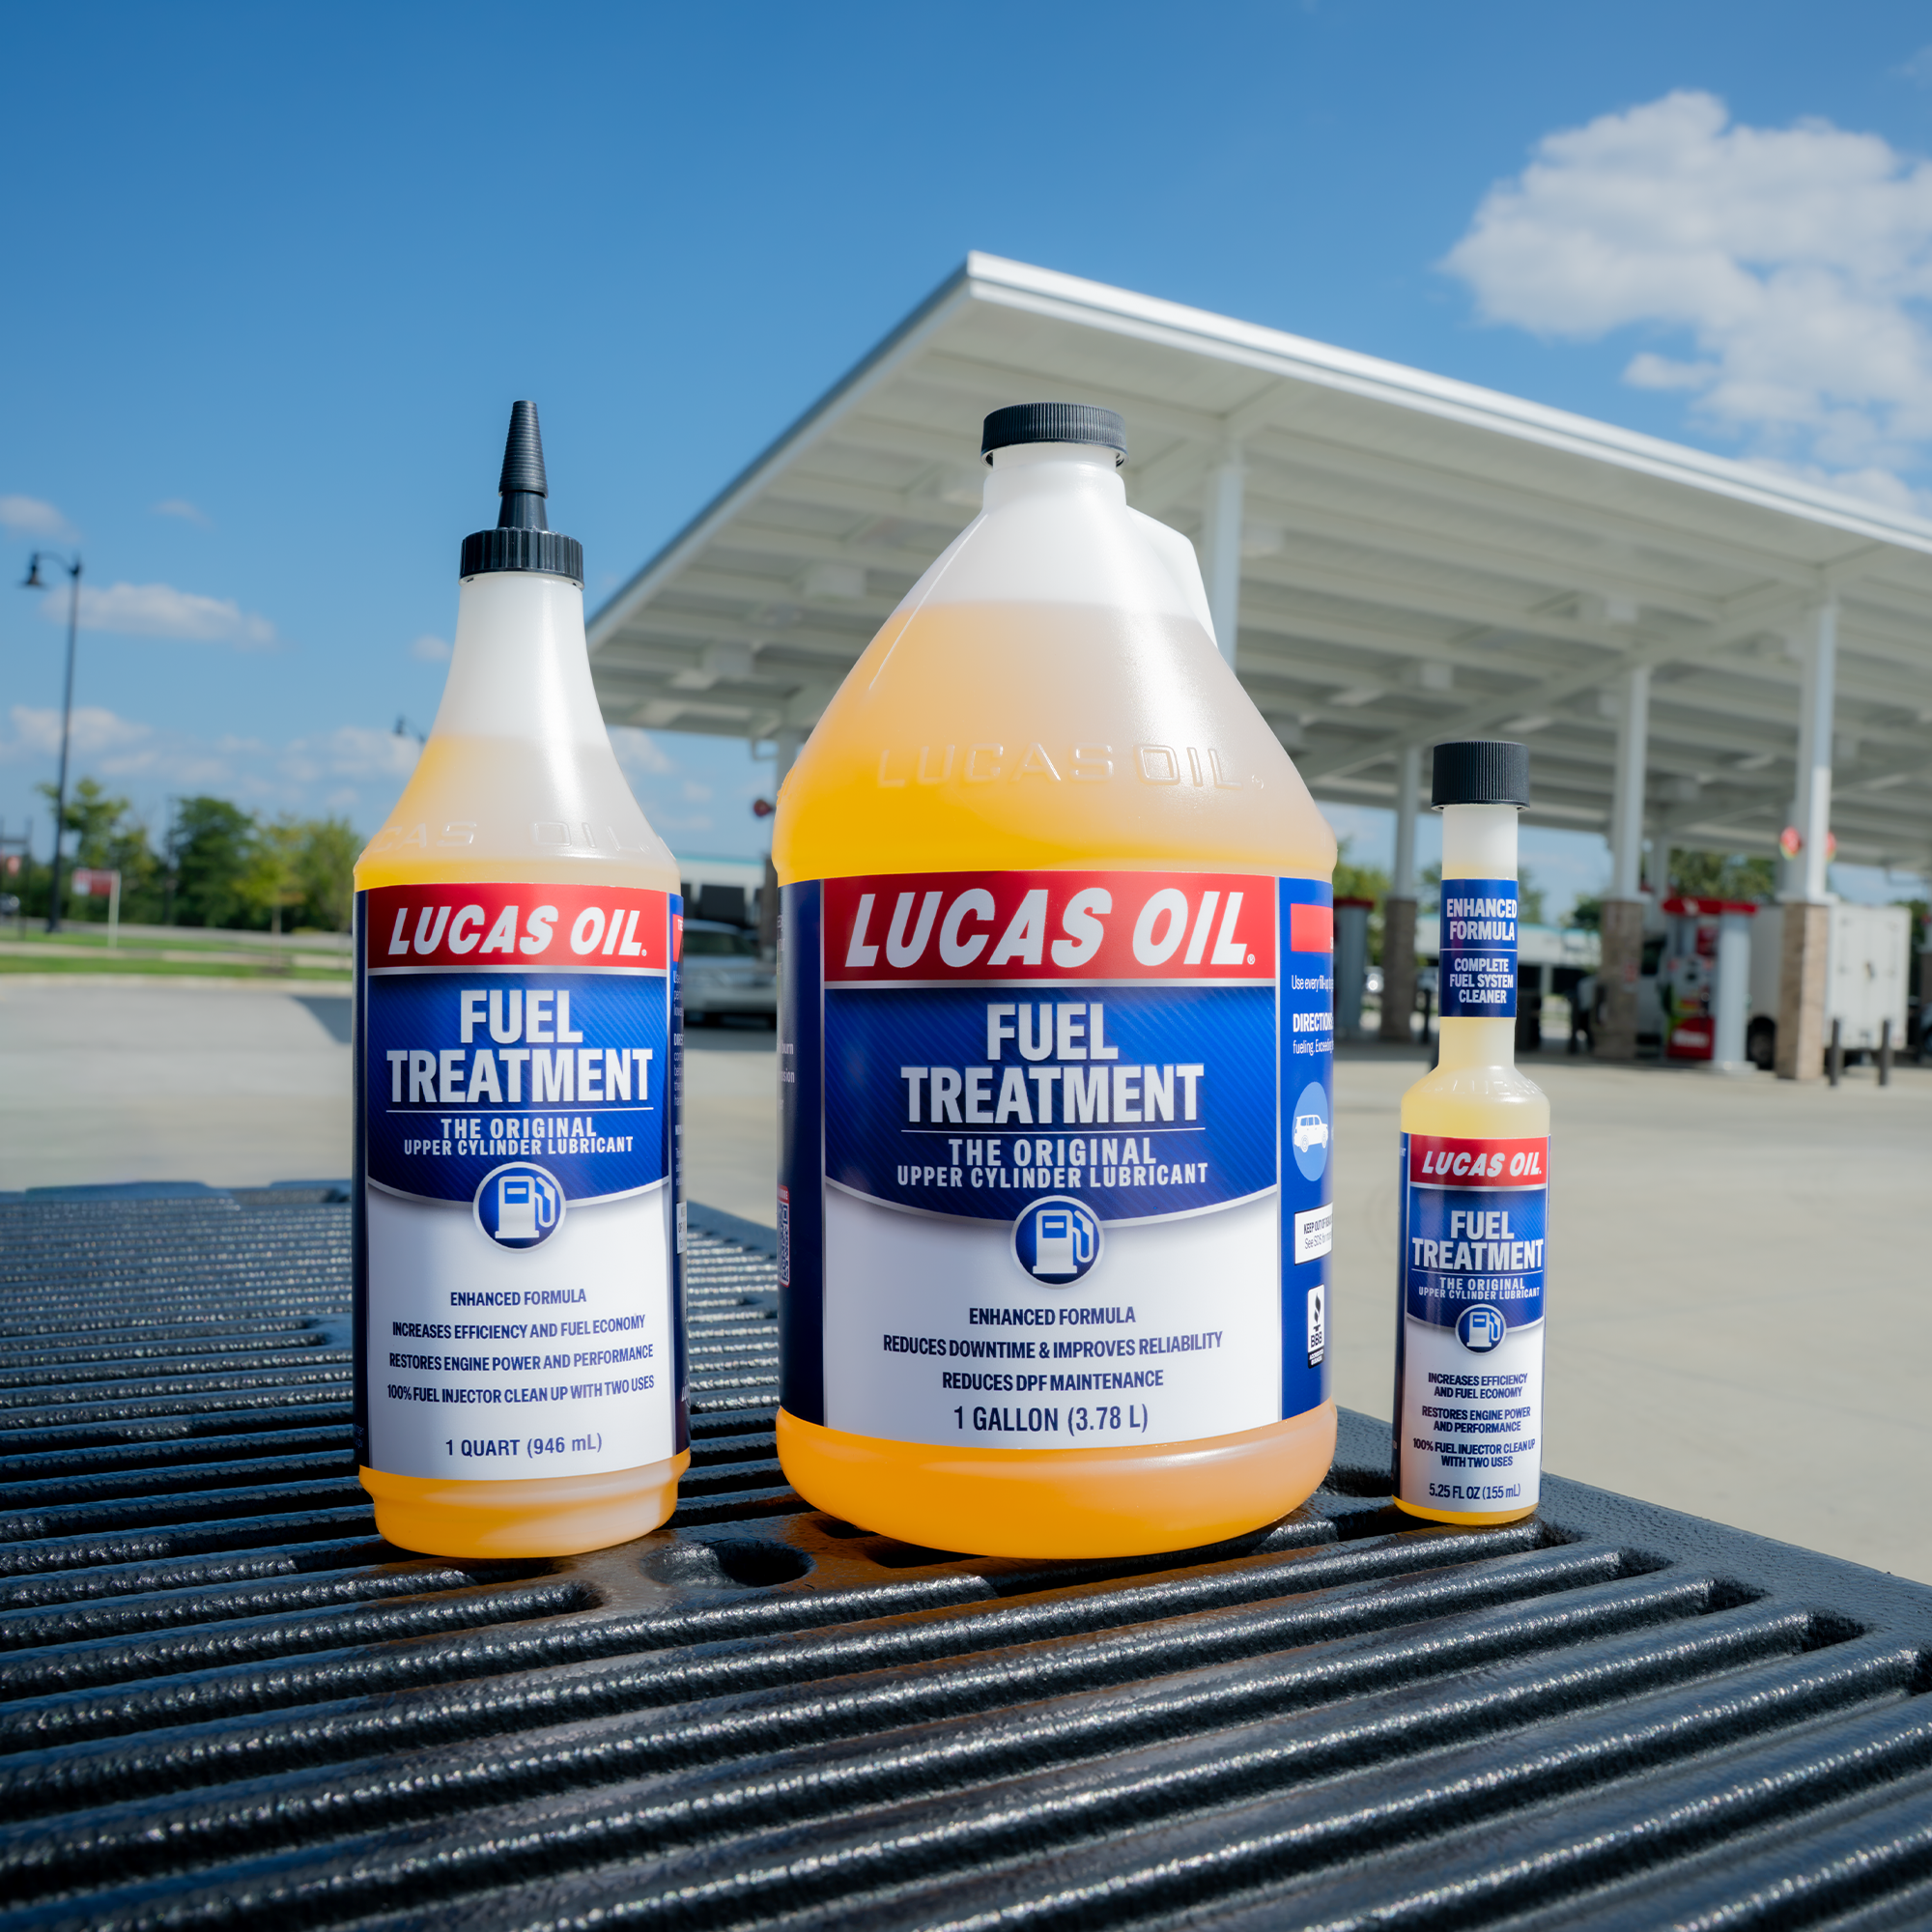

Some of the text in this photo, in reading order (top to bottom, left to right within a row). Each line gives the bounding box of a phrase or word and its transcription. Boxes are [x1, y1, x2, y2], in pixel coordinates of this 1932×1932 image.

[878, 742, 1115, 789] LUCAS
[373, 821, 477, 853] CAS
[1446, 898, 1517, 920] ENHANCED
[387, 904, 558, 956] LUCAS
[844, 887, 1112, 969] LUCAS
[1449, 921, 1516, 941] FORMULA
[1454, 957, 1509, 973] COMPLETE
[1291, 975, 1304, 990] Use
[1305, 978, 1320, 993] every
[1449, 973, 1514, 989] FUEL SYSTEM
[1458, 989, 1507, 1005] CLEANER
[460, 989, 583, 1044] FUEL
[986, 1003, 1119, 1063] FUEL
[1293, 1039, 1315, 1057] fueling.
[386, 1049, 653, 1103] TREATMENT
[900, 1064, 1205, 1124] TREATMENT
[440, 1117, 597, 1139] THE ORIGINAL
[404, 1136, 634, 1156] UPPER CYLINDER LUBRICANT
[949, 1138, 1157, 1168] THE ORIGINAL
[896, 1162, 1208, 1189] UPPER CYLINDER LUBRICANT
[1422, 1151, 1506, 1178] LUCAS
[1450, 1211, 1515, 1241] FUEL
[1304, 1237, 1314, 1249] See
[1411, 1237, 1544, 1271] TREATMENT
[1418, 1286, 1540, 1301] UPPER CYLINDER LUBRICANT
[1439, 1276, 1525, 1291] THE ORIGINAL
[450, 1289, 586, 1307] ENHANCED FORMULA
[392, 1314, 645, 1339] INCREASES EFFICIENCY AND FUEL ECONOMY
[969, 1306, 1136, 1326] ENHANCED FORMULA
[883, 1330, 1223, 1360] REDUCES DOWNTIME & IMPROVES RELIABILITY
[1310, 1331, 1322, 1349] BBB
[389, 1344, 654, 1372] RESTORES ENGINE POWER AND PERFORMANCE
[387, 1375, 655, 1404] 100% FUEL INJECTOR CLEAN UP WITH TWO USES
[942, 1369, 1164, 1393] REDUCES DPF MAINTENANCE
[1428, 1372, 1528, 1386] INCREASES EFFICIENCY
[1434, 1386, 1522, 1400] AND FUEL ECONOMY
[953, 1404, 1150, 1437] 1 GALLON (3.78 L)
[1422, 1406, 1531, 1421] RESTORES ENGINE POWER
[1434, 1421, 1521, 1434] AND PERFORMANCE
[446, 1432, 603, 1460] 1 QUART (946 mL)
[1412, 1437, 1434, 1451] 100%
[1435, 1441, 1457, 1454] FUEL
[1458, 1443, 1502, 1455] INJECTOR
[1503, 1440, 1528, 1455] CLEAN
[1528, 1438, 1536, 1451] UP
[1441, 1455, 1513, 1468] WITH TWO USES
[1429, 1483, 1521, 1500] 5.25 FL OZ (155 mL)
